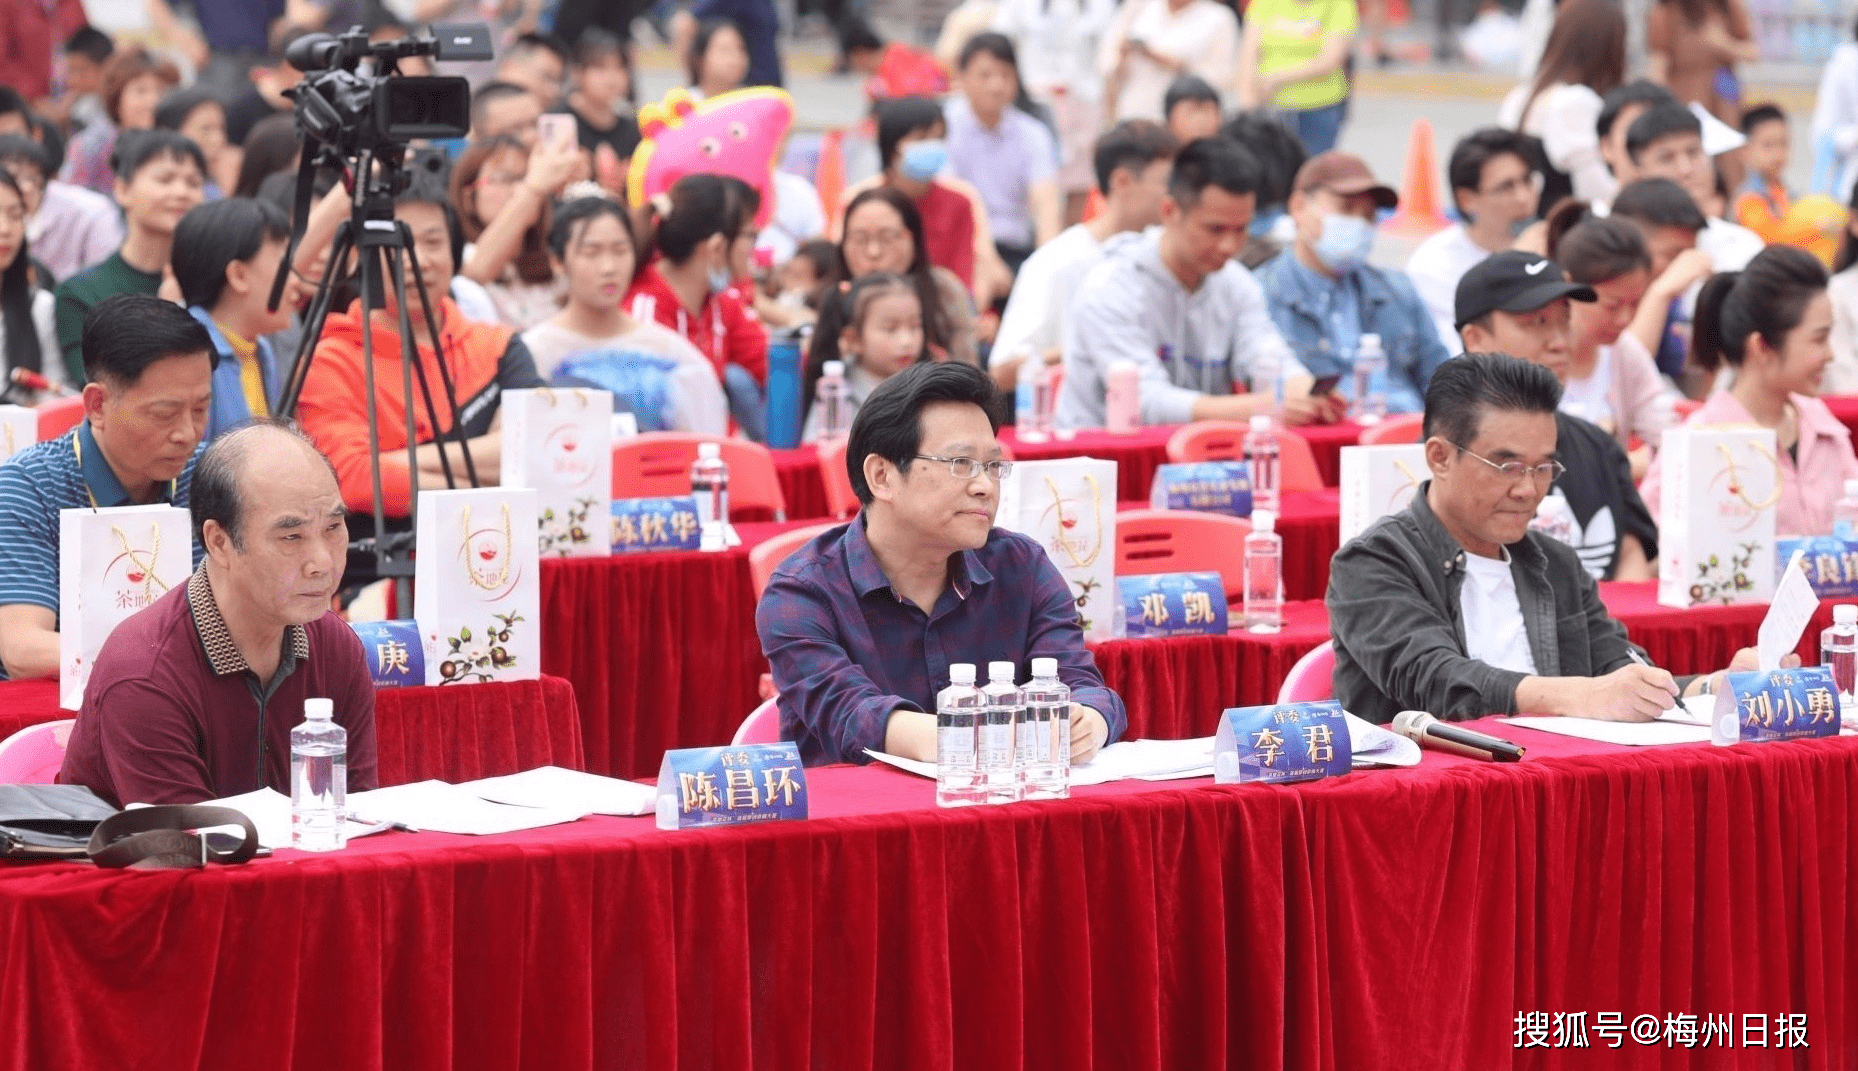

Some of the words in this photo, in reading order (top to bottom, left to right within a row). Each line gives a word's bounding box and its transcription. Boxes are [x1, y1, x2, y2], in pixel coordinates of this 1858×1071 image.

[1137, 591, 1215, 626] 邓凯
[376, 639, 410, 676] 庚
[1769, 673, 1796, 688] 评委
[1273, 708, 1300, 725] 评委
[1741, 686, 1835, 728] 刘小勇
[721, 751, 750, 767] 评委
[1251, 723, 1334, 767] 李君
[678, 765, 801, 814] 陈昌环
